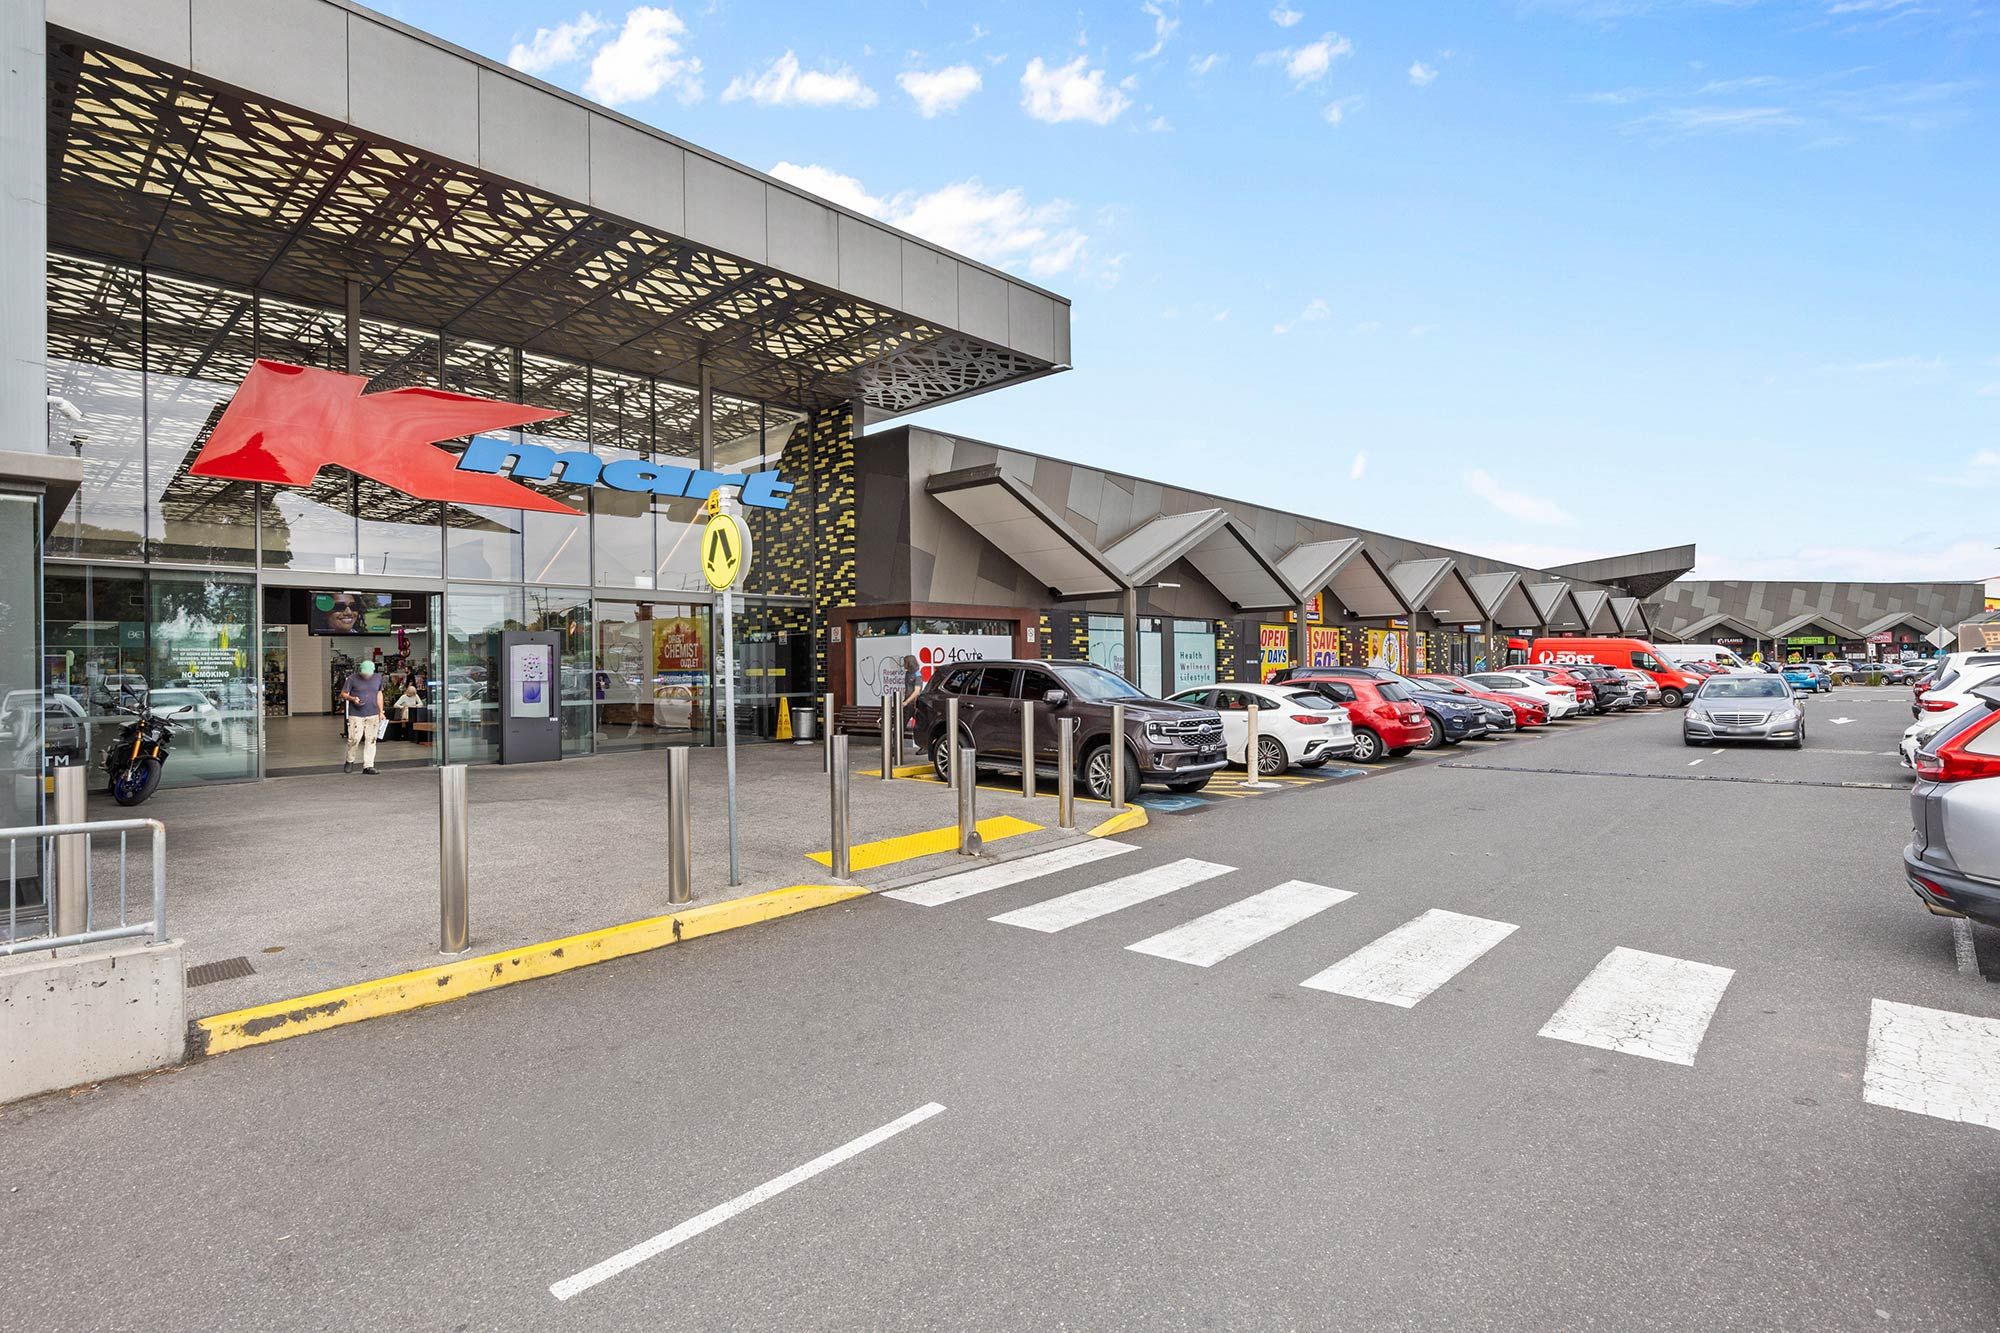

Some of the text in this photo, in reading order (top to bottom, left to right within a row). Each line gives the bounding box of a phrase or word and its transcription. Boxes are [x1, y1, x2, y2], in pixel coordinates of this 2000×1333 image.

[668, 634, 685, 643] DIRECT
[1261, 629, 1287, 647] OPEN
[1312, 630, 1338, 650] SAVE
[664, 644, 698, 658] CHEMIST
[1180, 651, 1203, 660] Health
[1260, 649, 1287, 663] 7 DAYS
[680, 658, 699, 668] OUTLET
[1556, 655, 1595, 665] POST
[1180, 662, 1210, 671] Wellness
[1180, 673, 1211, 683] Lifestyle
[44, 754, 70, 767] TM
